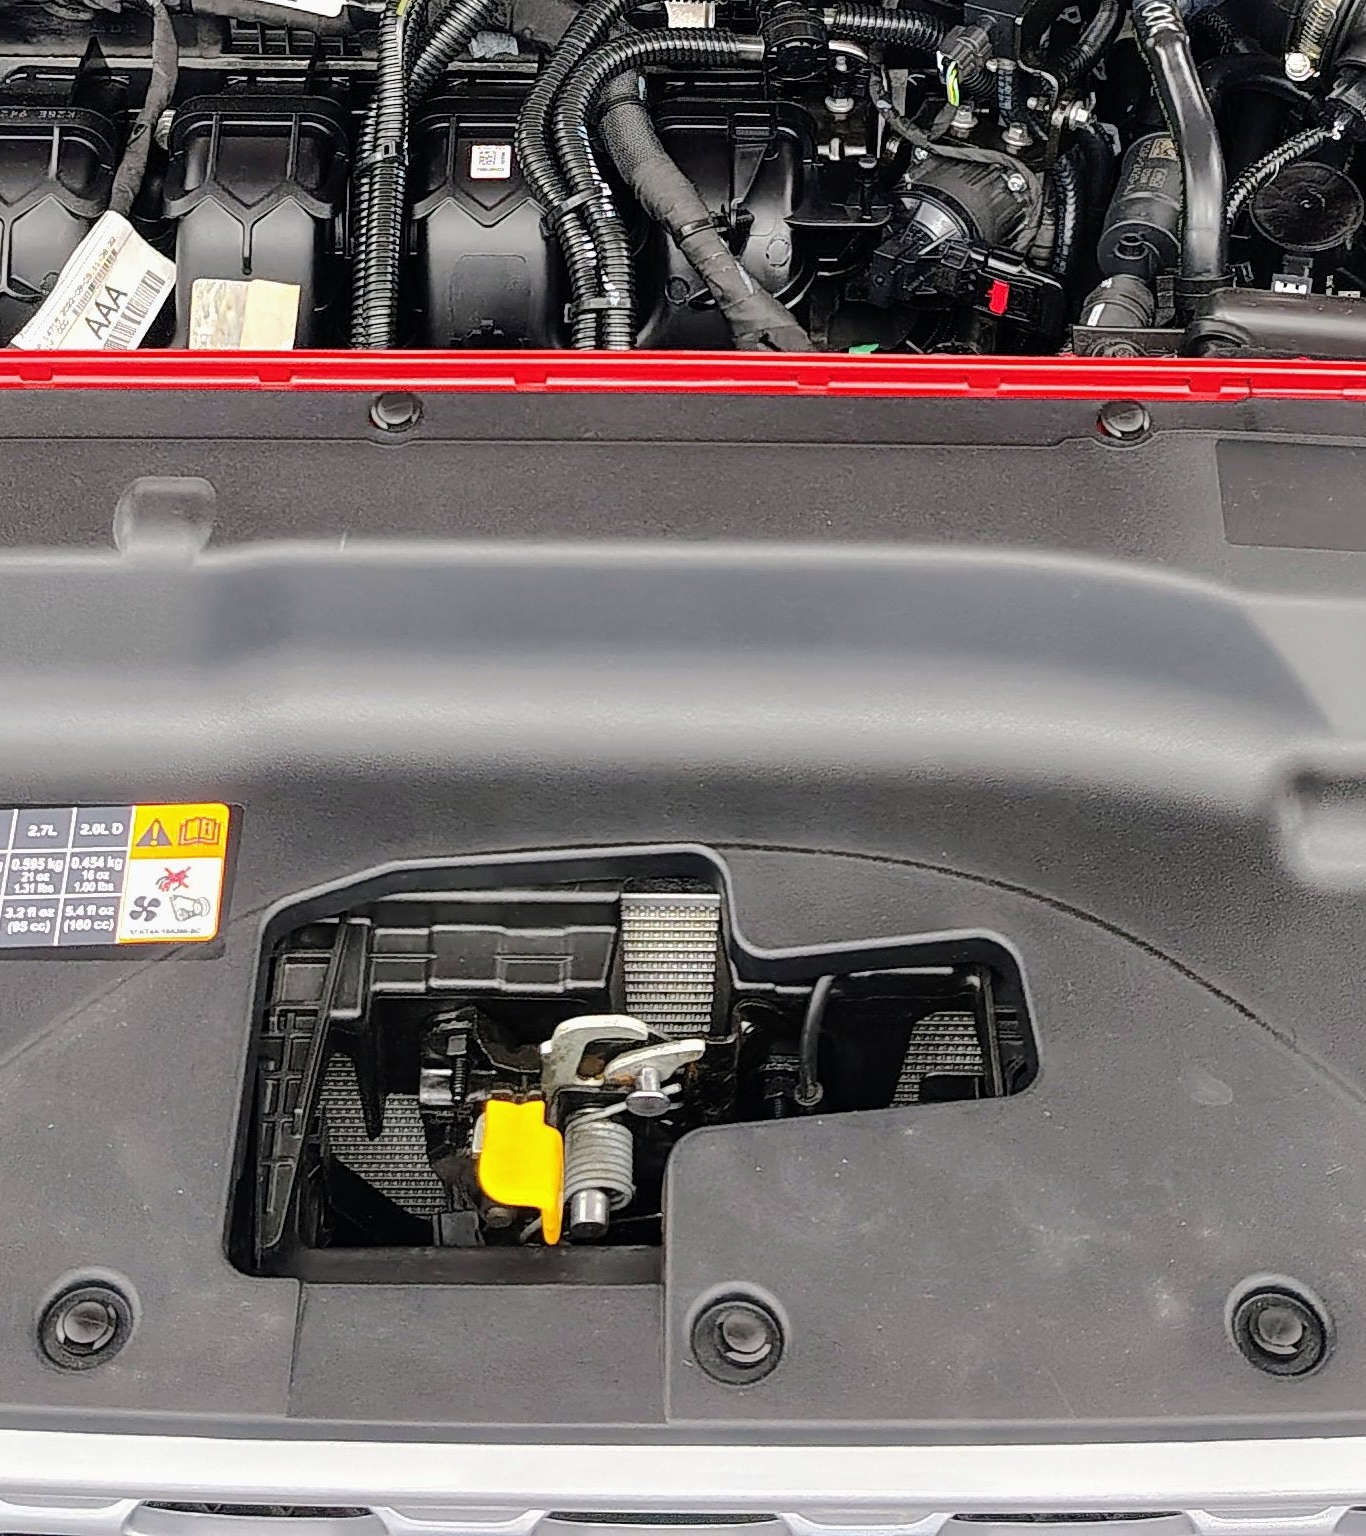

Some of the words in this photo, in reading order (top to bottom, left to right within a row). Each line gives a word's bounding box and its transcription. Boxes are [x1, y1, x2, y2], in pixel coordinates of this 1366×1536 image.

[84, 285, 129, 341] AAA
[27, 824, 58, 837] 2.7L
[79, 823, 110, 836] 2.0L
[111, 822, 124, 835] D
[47, 856, 64, 873] kg
[107, 855, 124, 871] kg
[36, 872, 51, 882] oz
[95, 871, 110, 880] oz
[38, 907, 56, 918] oz
[98, 906, 115, 916] oz
[29, 920, 51, 933] cc)
[93, 919, 115, 932] cc)
